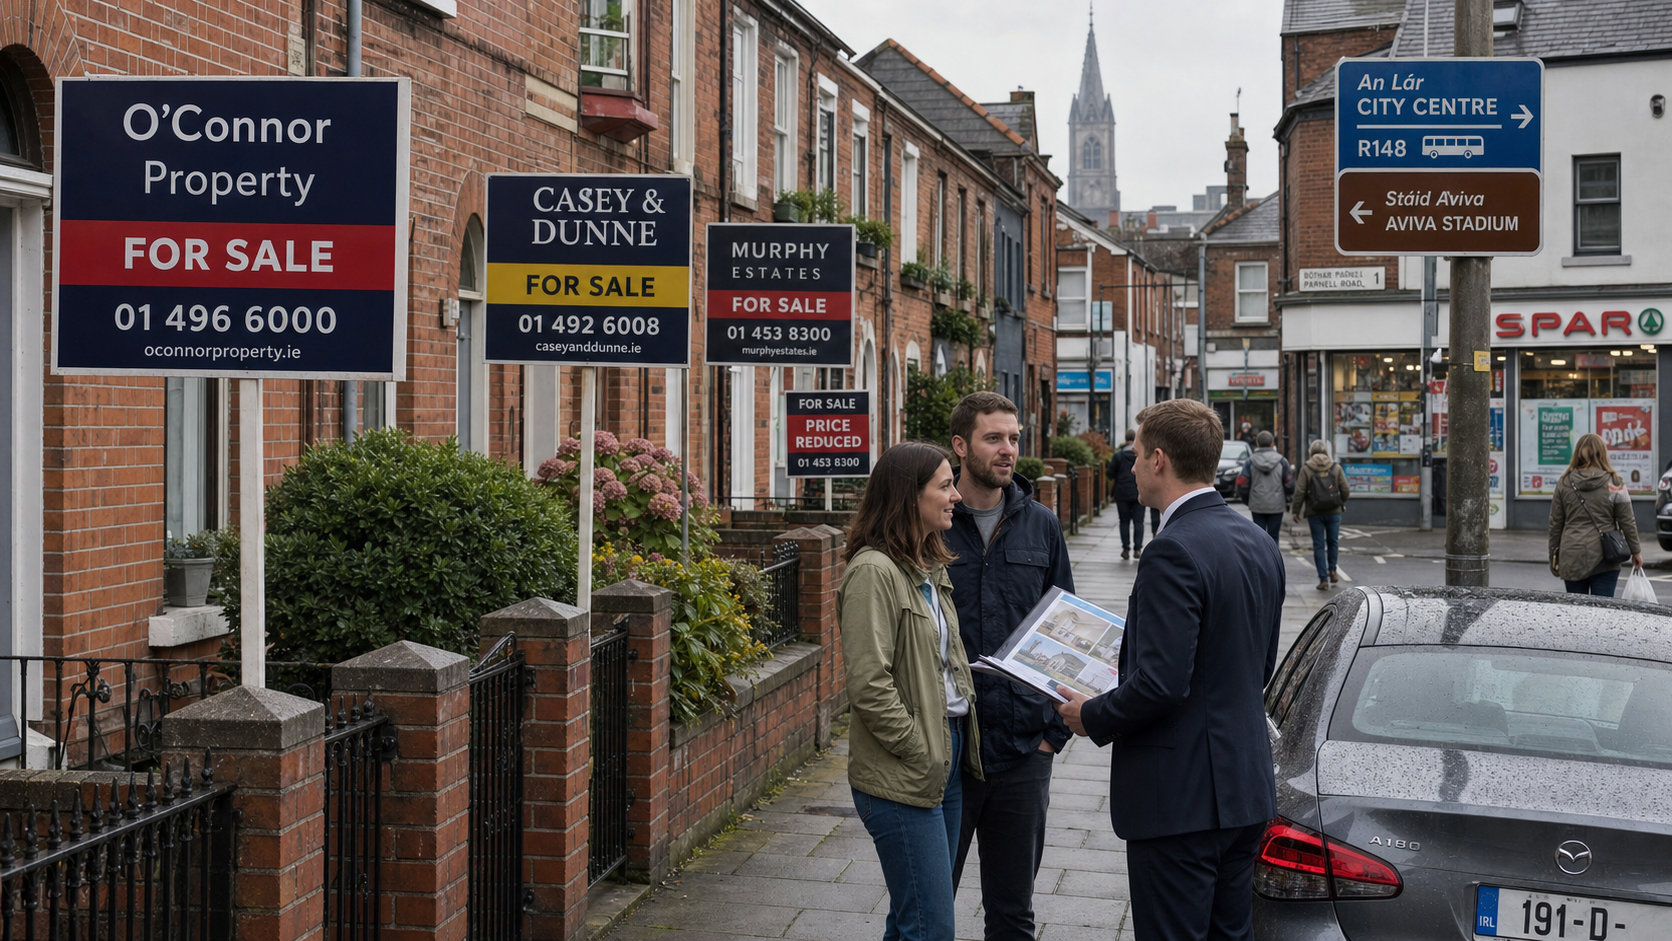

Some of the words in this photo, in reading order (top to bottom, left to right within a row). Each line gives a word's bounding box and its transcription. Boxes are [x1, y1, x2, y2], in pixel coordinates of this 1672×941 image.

[1357, 73, 1385, 91] An
[1391, 73, 1425, 91] Lár
[1357, 97, 1406, 116] CITY
[1412, 97, 1498, 116] CENTRE
[123, 102, 332, 144] O'Connor
[1358, 139, 1407, 158] R148
[144, 160, 316, 207] Property
[533, 186, 635, 213] CASEY
[642, 188, 666, 214] &
[1385, 190, 1432, 207] Stáid
[1435, 190, 1485, 207] Aviva
[1385, 215, 1437, 231] AVIVA
[1442, 215, 1519, 231] STADIUM
[531, 218, 658, 247] DUNNE
[124, 236, 211, 271] FOR
[225, 238, 334, 273] SALE
[732, 241, 830, 260] MURPHY
[732, 266, 821, 280] ESTATES
[1374, 272, 1379, 284] 1
[526, 274, 580, 296] FOR
[588, 275, 655, 298] SALE
[732, 296, 771, 313] FOR
[778, 297, 827, 314] SALE
[114, 303, 151, 331] 01
[165, 304, 231, 333] 496
[244, 305, 337, 334] 6000
[518, 314, 543, 333] 01
[551, 315, 595, 334] 492
[602, 315, 660, 336] 6008
[1495, 310, 1633, 337] SPAR
[727, 325, 745, 341] 01
[751, 326, 783, 341] 453
[788, 326, 831, 342] 8300
[144, 344, 301, 362] oconnorproperty.ie
[535, 340, 642, 354] caseyanddunne.ie
[741, 345, 818, 357] murphyestates.ie
[799, 398, 823, 410] FOR
[826, 398, 856, 410] SALE
[806, 418, 851, 432] PRICE
[795, 435, 862, 448] REDUCED
[797, 457, 810, 468] 01
[812, 457, 832, 468] 453
[834, 457, 860, 467] 8300
[1479, 915, 1496, 928] IRL
